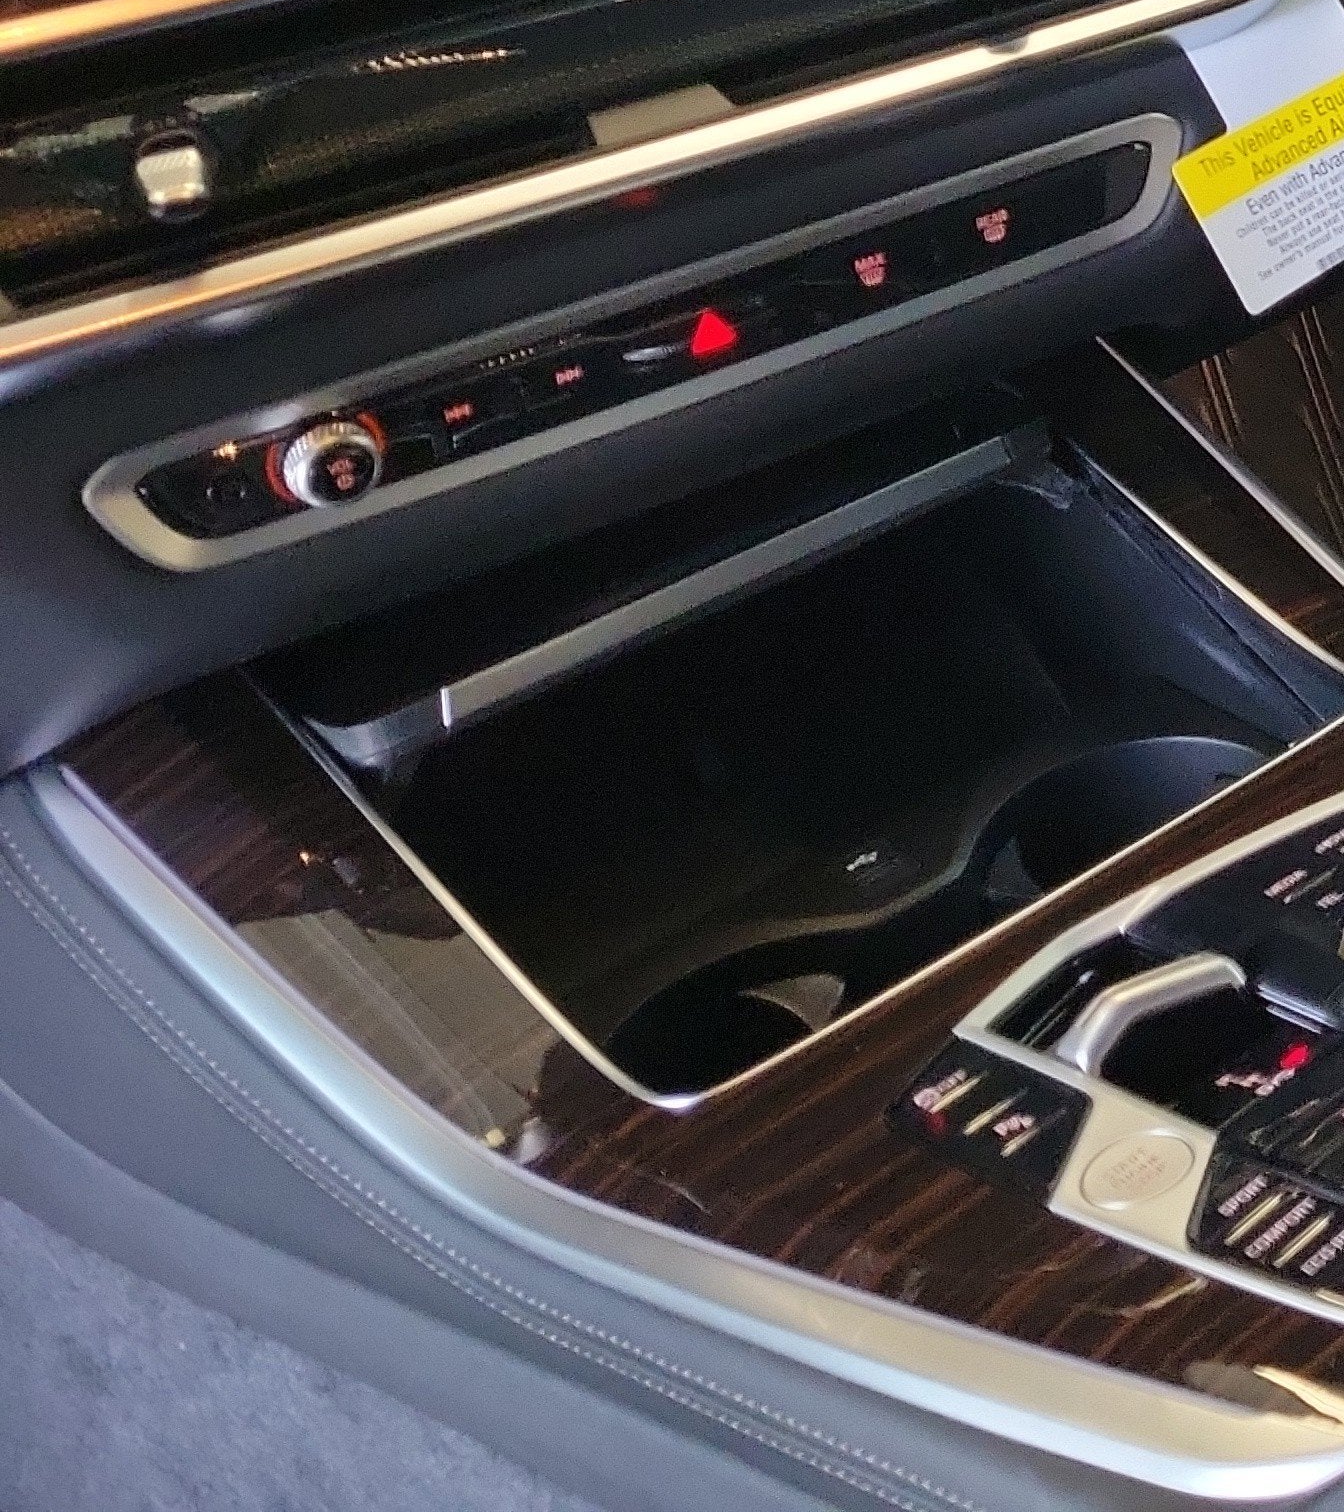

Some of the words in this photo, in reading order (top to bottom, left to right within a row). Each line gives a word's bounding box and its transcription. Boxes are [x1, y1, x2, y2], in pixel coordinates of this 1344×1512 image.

[1197, 150, 1236, 177] This
[1233, 118, 1294, 157] Vehicle
[1251, 125, 1327, 180] Advanced
[1245, 189, 1280, 215] Even
[1278, 171, 1309, 196] with
[1244, 1195, 1316, 1259] COMFORT
